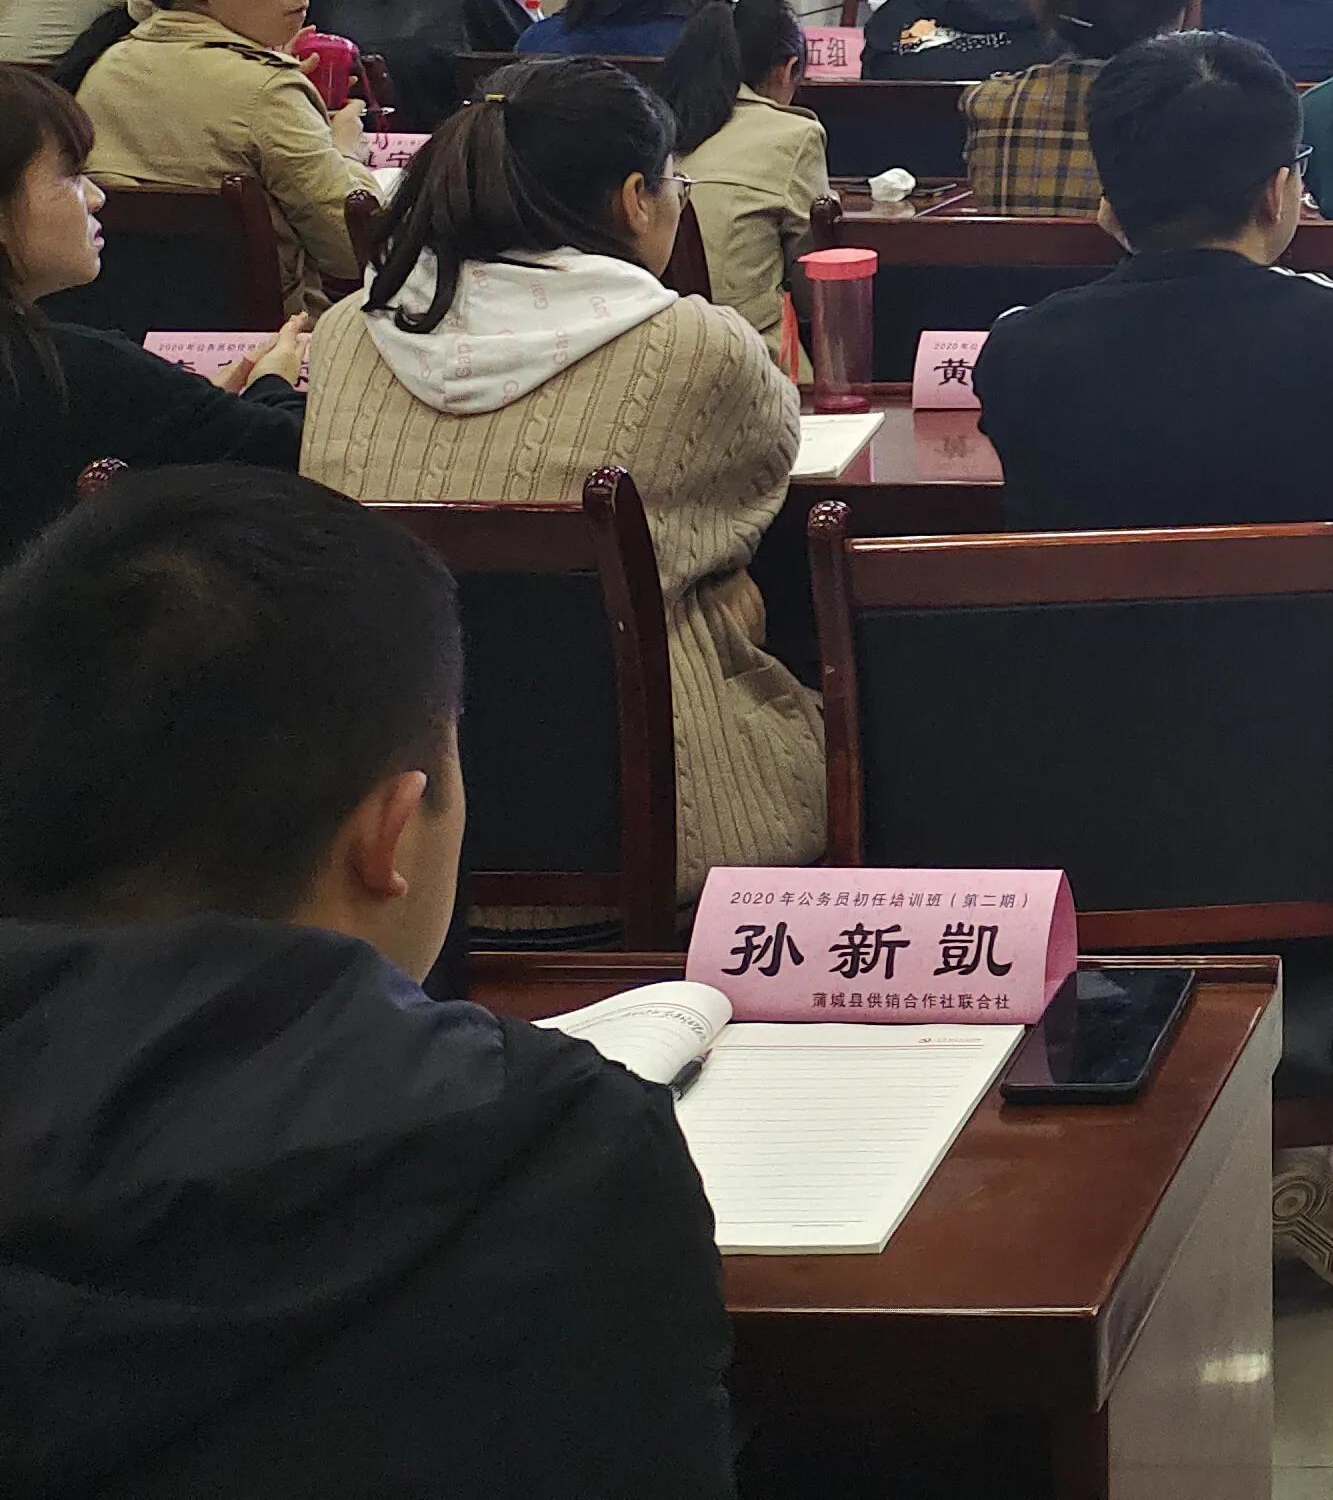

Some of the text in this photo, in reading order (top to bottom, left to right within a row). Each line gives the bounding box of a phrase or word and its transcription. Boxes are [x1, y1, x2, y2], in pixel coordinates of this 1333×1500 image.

[934, 358, 976, 385] 黄
[812, 992, 1011, 1010] 蒲城县供销合作社联合社
